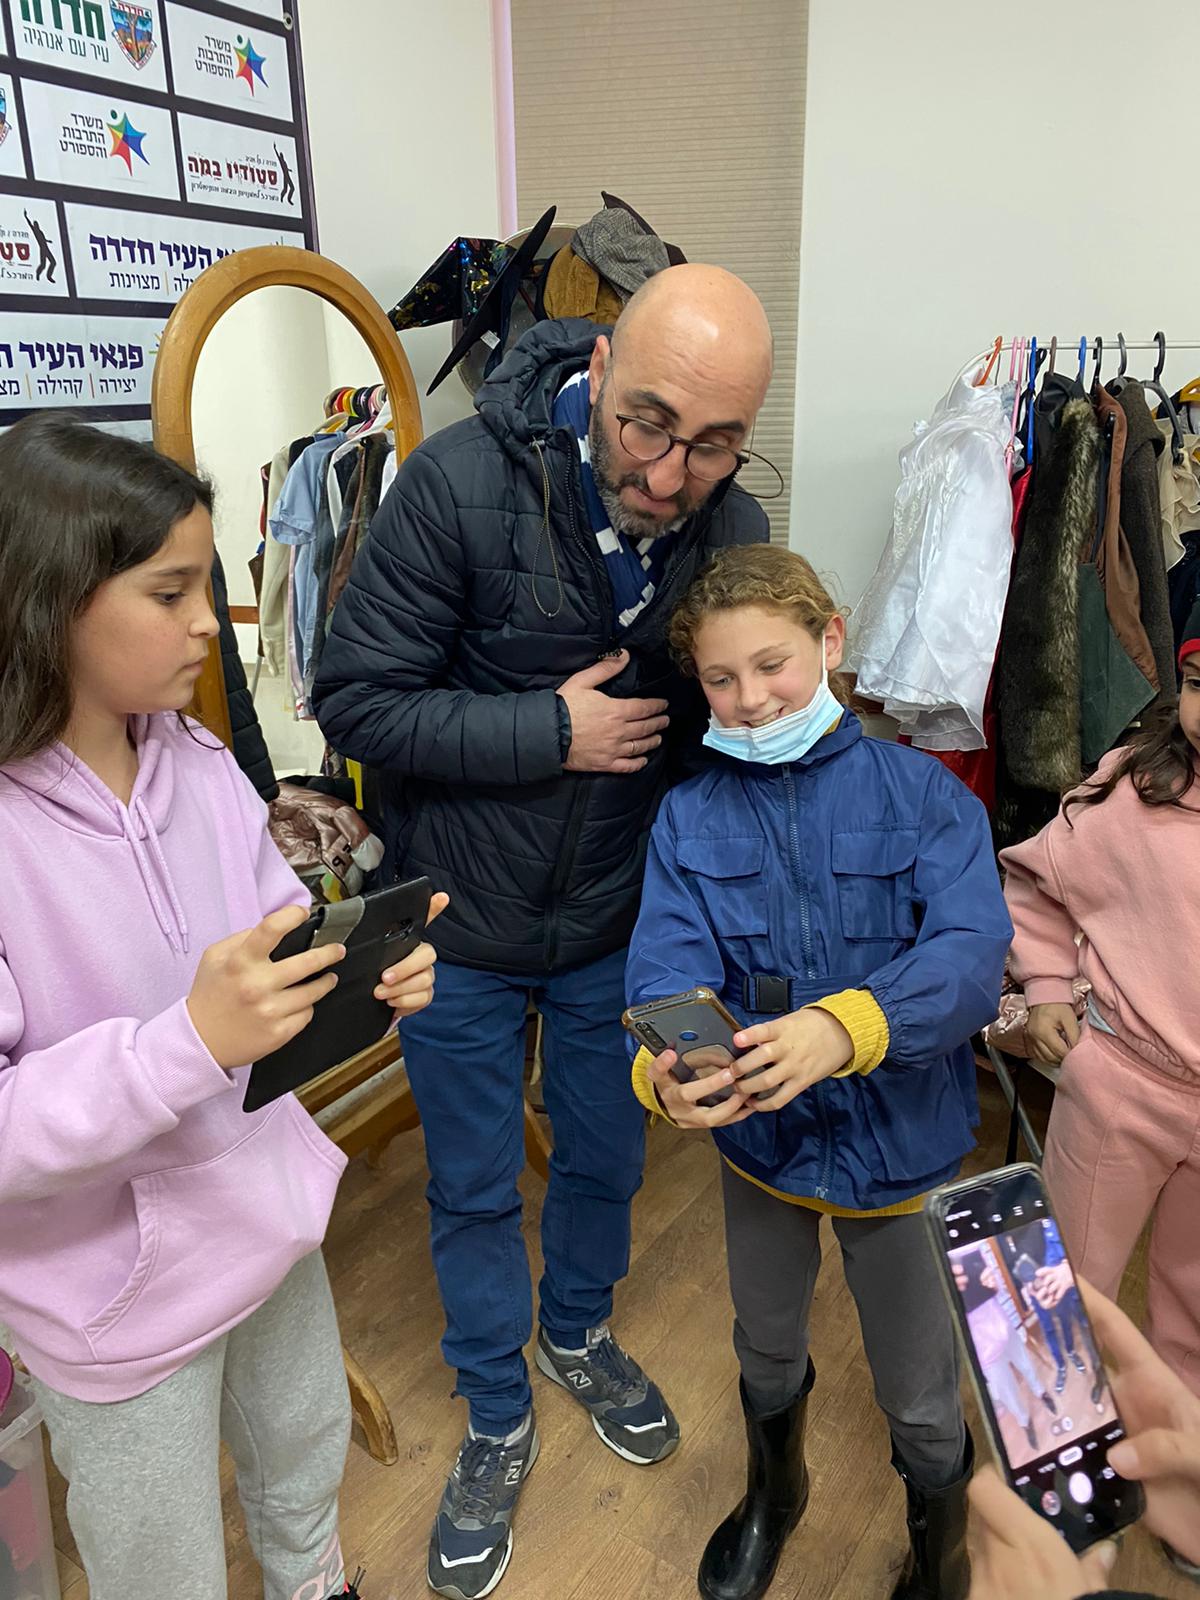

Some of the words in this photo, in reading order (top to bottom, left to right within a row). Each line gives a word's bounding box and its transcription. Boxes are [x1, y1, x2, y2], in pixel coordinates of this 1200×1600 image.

[23, 26, 64, 52] אנרגיה
[68, 37, 87, 57] עם
[204, 35, 232, 53] משרד
[90, 43, 109, 63] עיר
[197, 46, 233, 66] התרבות
[194, 59, 235, 79] והספורט
[70, 112, 104, 130] משרד
[62, 126, 106, 145] התרבות
[59, 139, 108, 159] והספורט
[226, 161, 278, 186] סטודיו
[0, 242, 30, 261] סט
[89, 233, 155, 265] חדרה
[159, 241, 212, 270] העיר
[109, 272, 161, 290] מצוינות
[18, 341, 85, 371] העיר
[89, 342, 144, 370] פנאי
[0, 379, 21, 396] מצ
[37, 374, 83, 399] קהילה
[99, 378, 137, 394] יצירה
[566, 1369, 593, 1390] N
[504, 1459, 524, 1486] N
